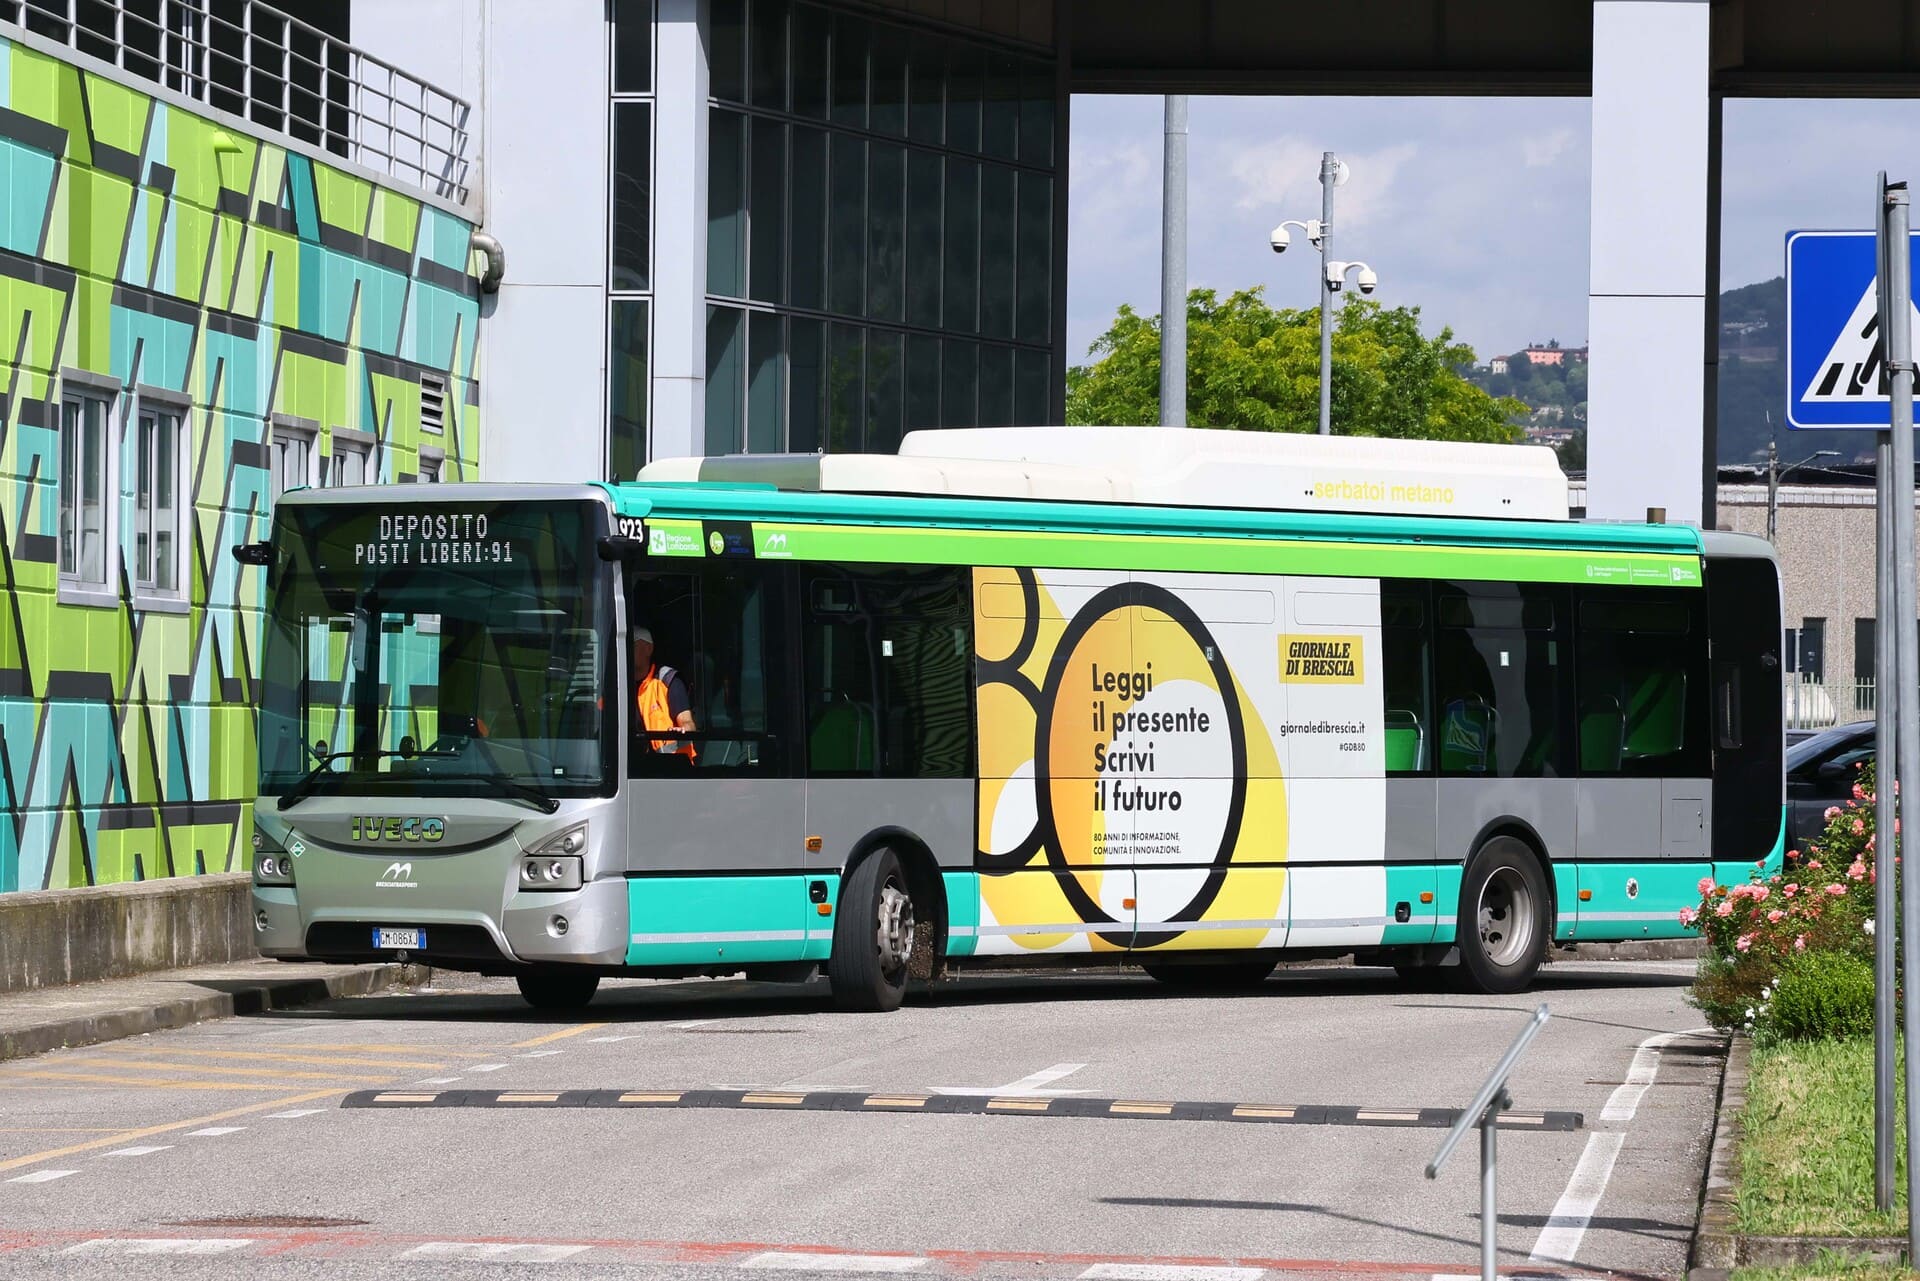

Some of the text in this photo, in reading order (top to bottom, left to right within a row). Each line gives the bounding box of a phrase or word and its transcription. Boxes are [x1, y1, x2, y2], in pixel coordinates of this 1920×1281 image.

[1314, 480, 1455, 505] serbatoi metano
[380, 514, 488, 540] DEPOSITO
[355, 541, 513, 565] POSTI LIBERI:91
[1289, 641, 1351, 659] GIORNALE
[1285, 659, 1355, 677] DI BRESCIA
[1092, 662, 1152, 701] Leggi
[1093, 701, 1210, 741] il presente
[1280, 721, 1365, 737] giornaledibrescia.it
[1094, 742, 1155, 772] Scrivi
[1339, 742, 1366, 752] #GDB80
[1094, 780, 1182, 811] il futuro
[351, 816, 445, 842] IVECO
[1093, 833, 1102, 841] 80
[1103, 833, 1120, 841] ANNI
[1121, 833, 1129, 841] DI
